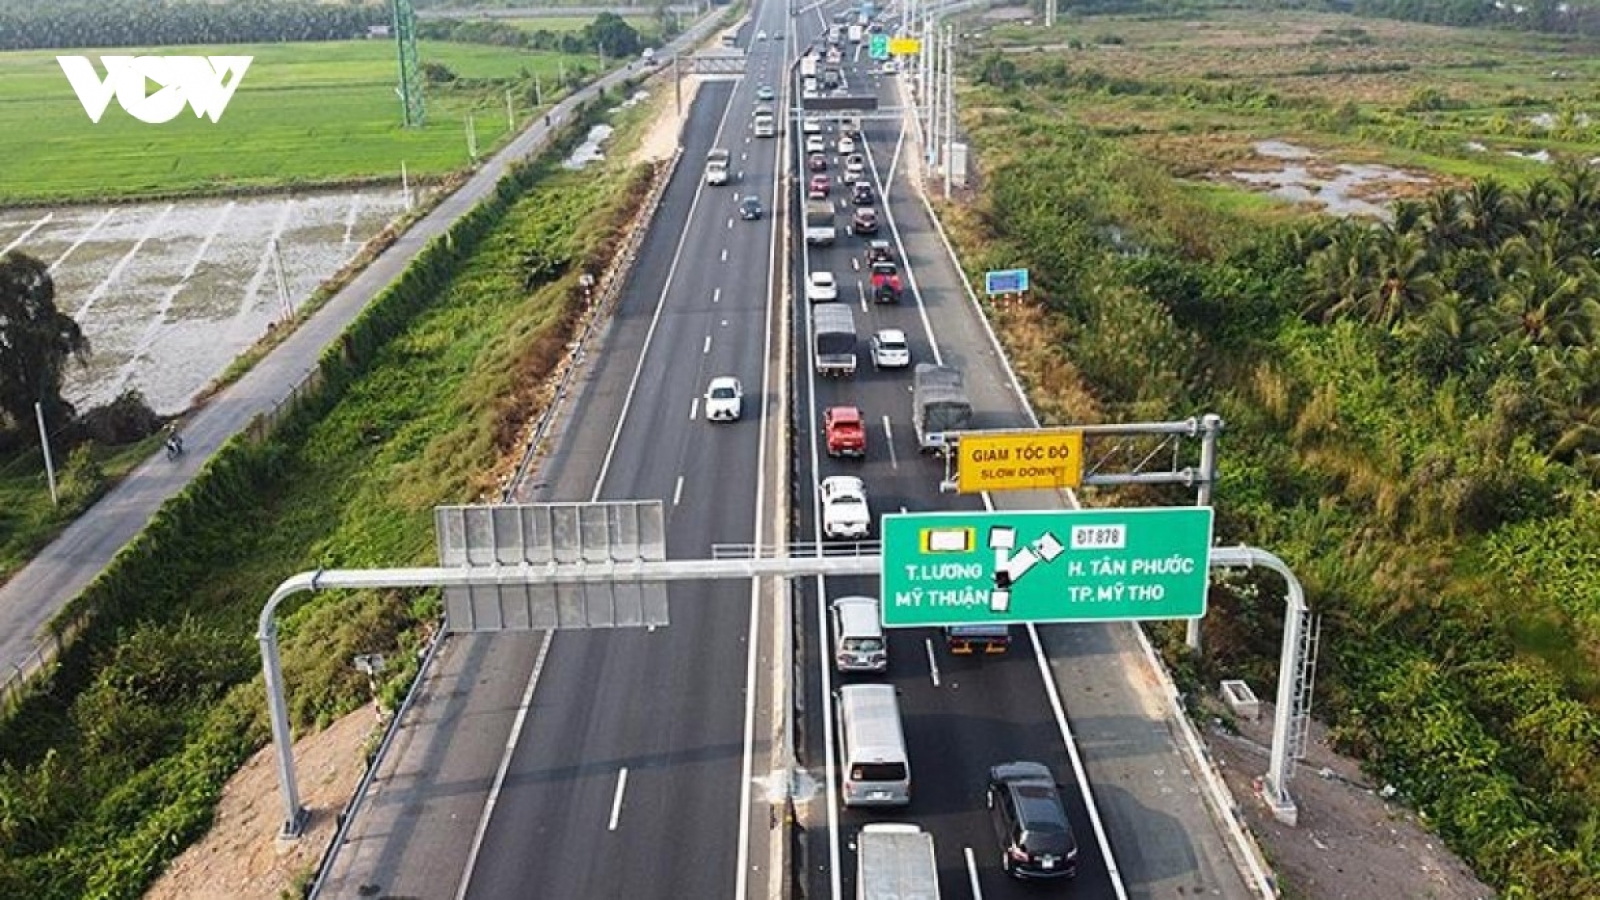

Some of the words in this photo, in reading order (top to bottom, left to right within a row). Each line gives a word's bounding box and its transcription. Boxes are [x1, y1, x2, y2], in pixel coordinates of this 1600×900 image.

[1015, 441, 1045, 460] TỐC
[1048, 443, 1069, 461] ĐỘ
[981, 468, 1016, 480] SLOW
[1068, 561, 1086, 577] H.
[1090, 555, 1127, 576] TÂN
[1131, 553, 1195, 575] PHƯỚC
[895, 587, 923, 607] MỸ
[927, 585, 989, 610] THUẬN
[1127, 584, 1165, 601] THO
